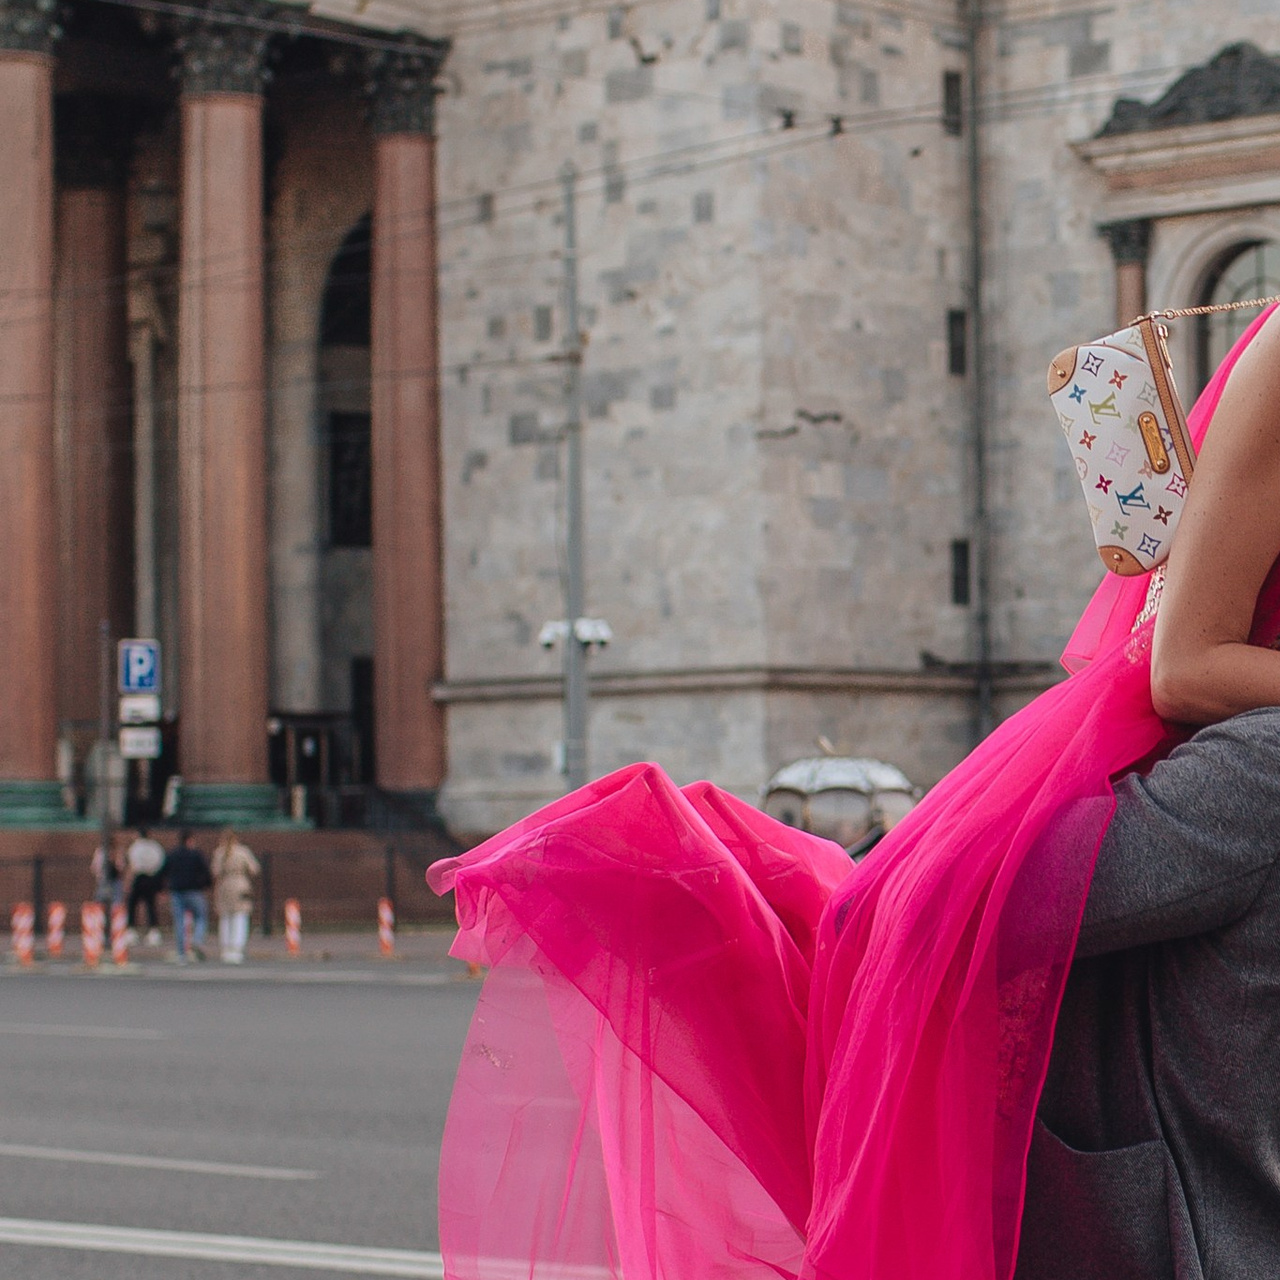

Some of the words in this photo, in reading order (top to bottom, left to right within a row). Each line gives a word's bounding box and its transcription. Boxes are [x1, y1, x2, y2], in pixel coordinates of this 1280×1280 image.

[1088, 391, 1121, 424] LV
[1115, 482, 1151, 516] LV
[129, 645, 153, 687] P
